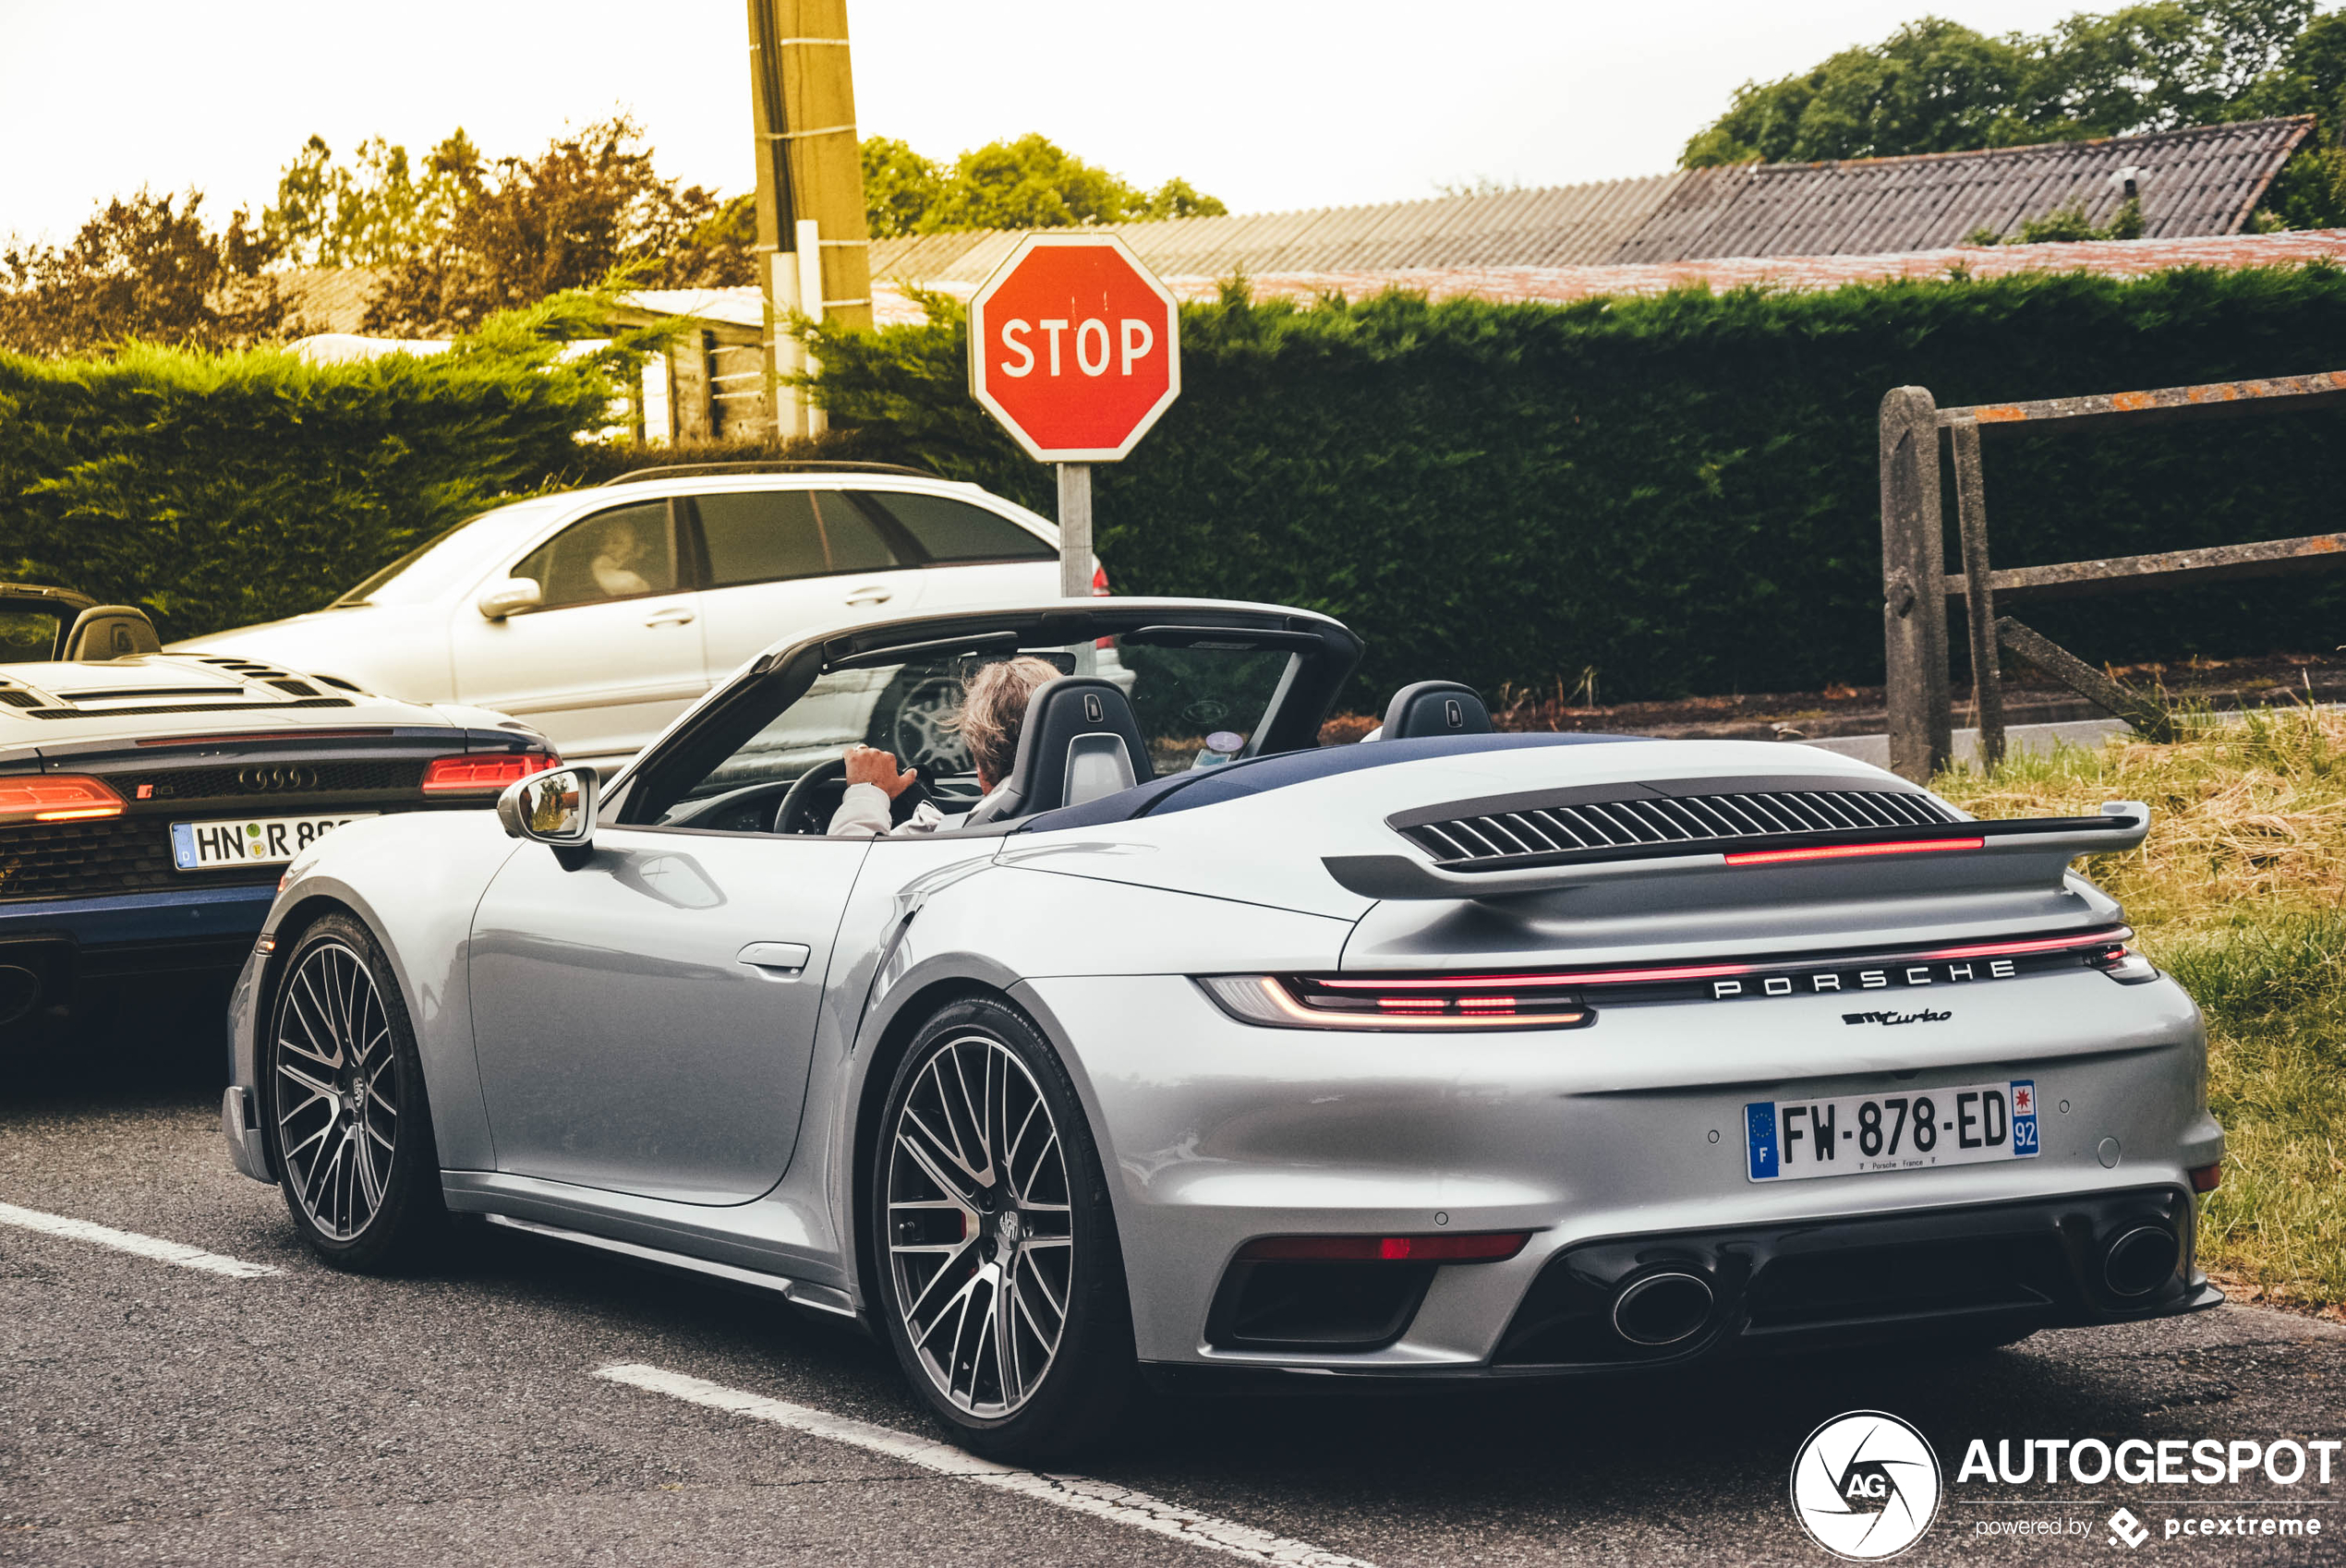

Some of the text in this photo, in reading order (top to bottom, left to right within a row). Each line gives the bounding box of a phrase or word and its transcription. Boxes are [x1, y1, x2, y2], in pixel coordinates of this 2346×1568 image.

[1001, 318, 1154, 378] STOP
[182, 850, 190, 862] D
[197, 826, 246, 861] HN
[267, 823, 291, 856] R
[1713, 960, 2015, 998] PORSCHE
[1783, 1091, 2007, 1164] FW-878-ED
[2015, 1122, 2037, 1147] 92
[1760, 1147, 1769, 1164] F
[1872, 1159, 1924, 1170] Porsche France
